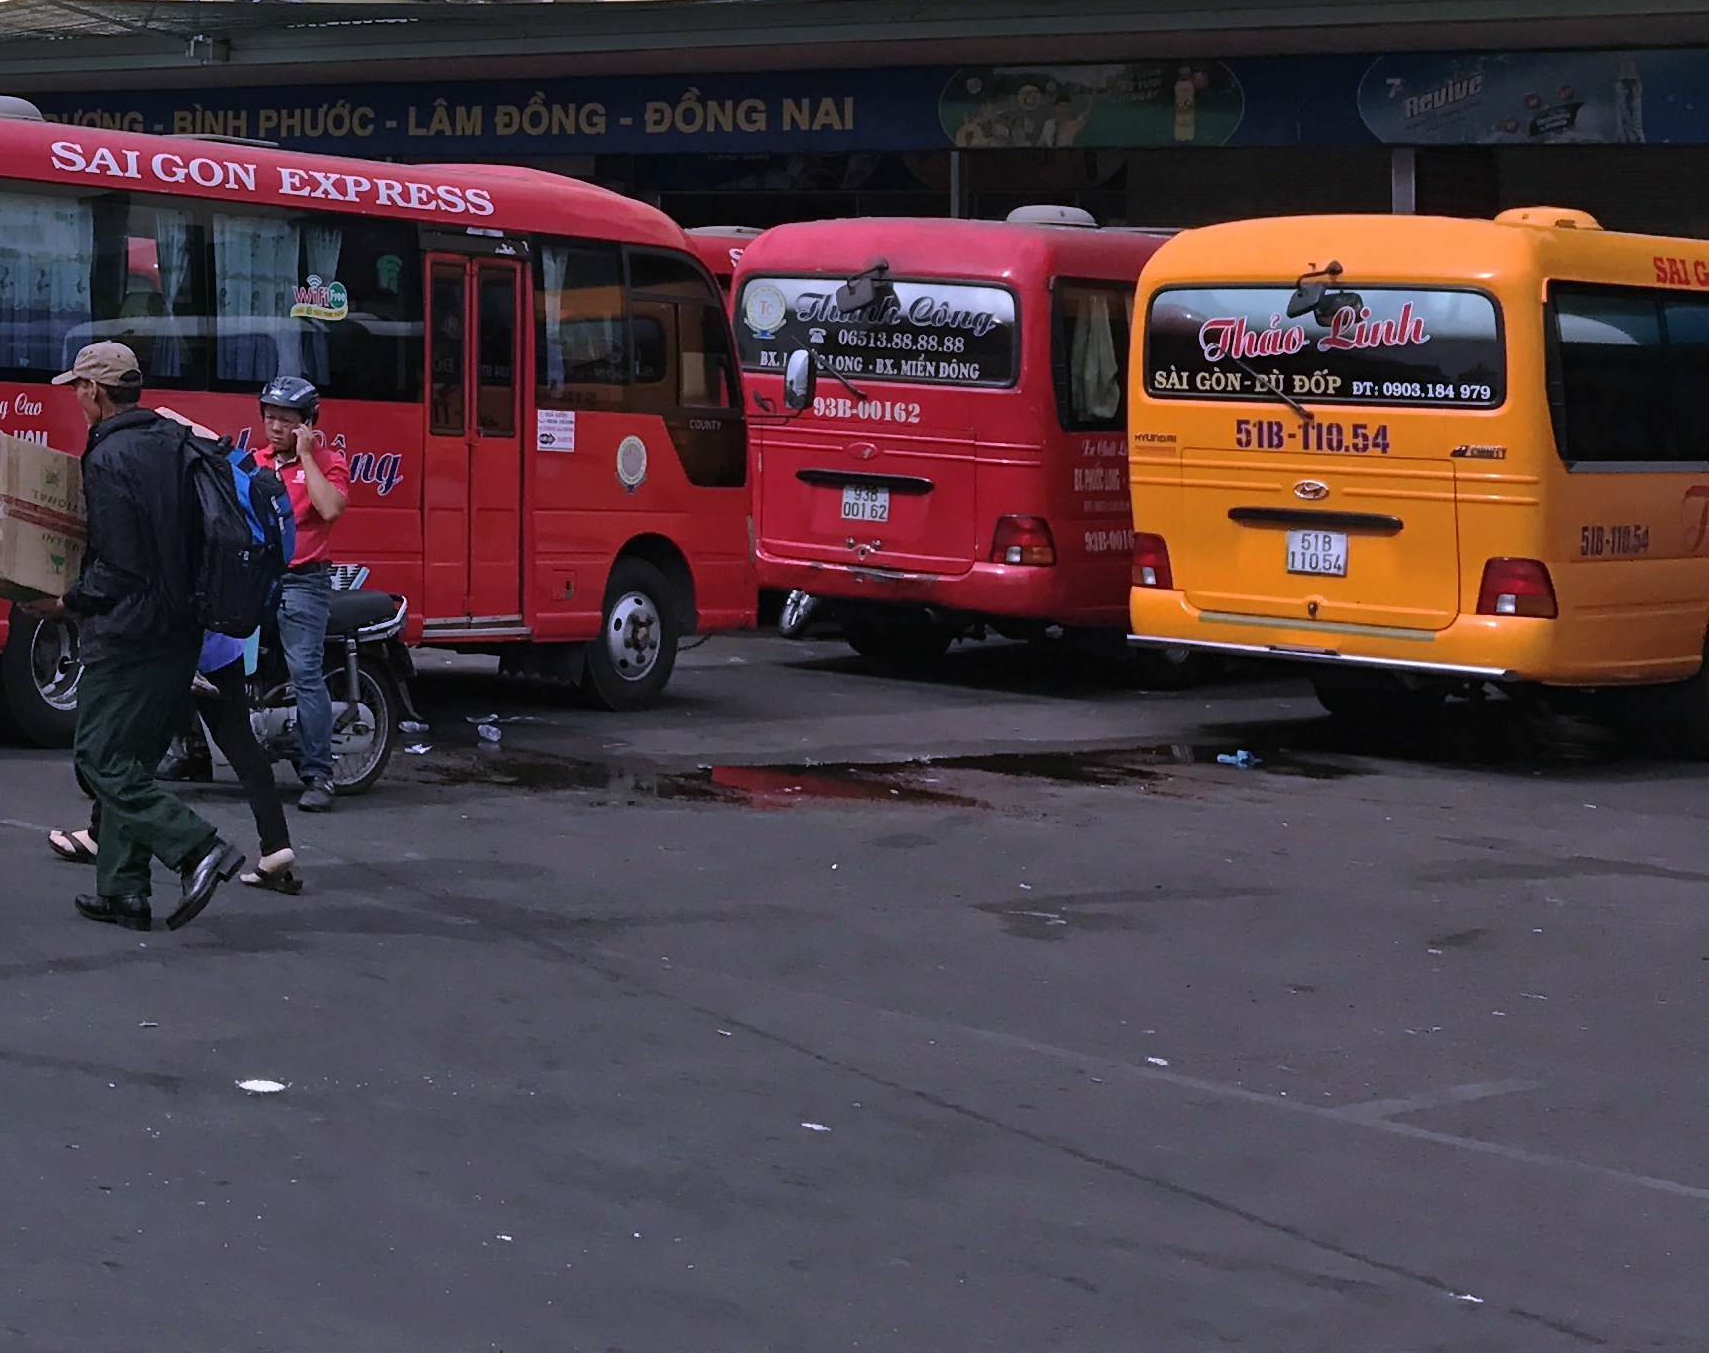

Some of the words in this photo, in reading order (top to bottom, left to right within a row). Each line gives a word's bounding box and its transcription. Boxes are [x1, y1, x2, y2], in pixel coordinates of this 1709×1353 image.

[172, 103, 247, 138] BÌNH
[258, 100, 375, 138] PHƯỚC
[408, 97, 482, 137] LÂM
[493, 90, 607, 137] ĐỒNG
[643, 87, 767, 134] ĐỒNG
[781, 96, 855, 132] NAI
[151, 153, 257, 190] GON
[278, 165, 497, 218] EXPRESS
[907, 295, 996, 337] Công
[1198, 313, 1311, 362] Thảo
[1316, 300, 1432, 353] Linh
[837, 328, 965, 353] 06513.88.88.88
[938, 358, 981, 380] ĐÔNG
[1154, 364, 1190, 390] SÀI
[1292, 367, 1343, 395] ĐỐP
[1383, 383, 1455, 399] 0903.184
[1460, 384, 1491, 400] 979
[14, 392, 43, 416] Cao
[813, 396, 921, 424] 93B-00162
[689, 419, 722, 431] COUNTY
[1235, 419, 1390, 454] 51B-110.54
[1301, 533, 1332, 552] 51B
